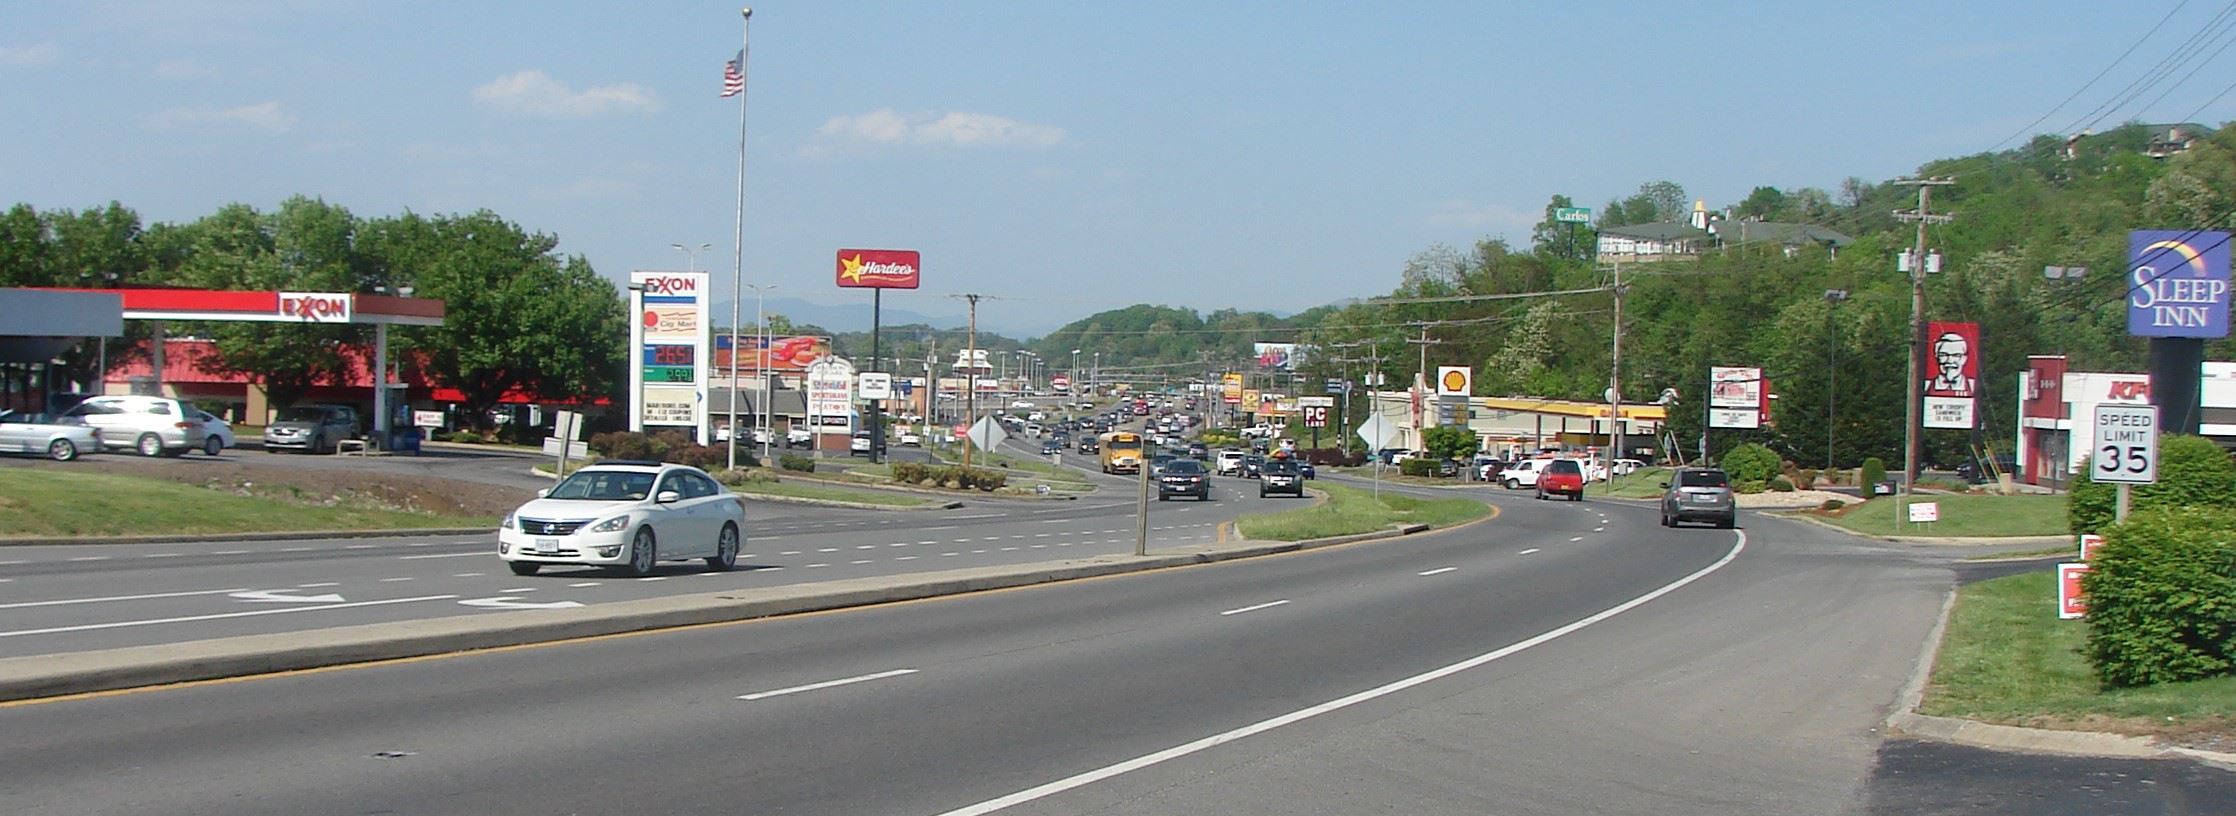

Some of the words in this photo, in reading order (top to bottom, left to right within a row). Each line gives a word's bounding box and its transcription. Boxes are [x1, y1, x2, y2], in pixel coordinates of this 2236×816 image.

[1556, 208, 1589, 222] Carlos
[645, 276, 695, 295] EXXON
[2132, 265, 2226, 309] SLEEP
[282, 296, 346, 322] EXXON
[2152, 305, 2209, 327] INN
[1306, 408, 1326, 420] PC
[2100, 414, 2152, 427] SPEED
[2104, 431, 2146, 442] LIMIT
[2100, 445, 2148, 473] 35
